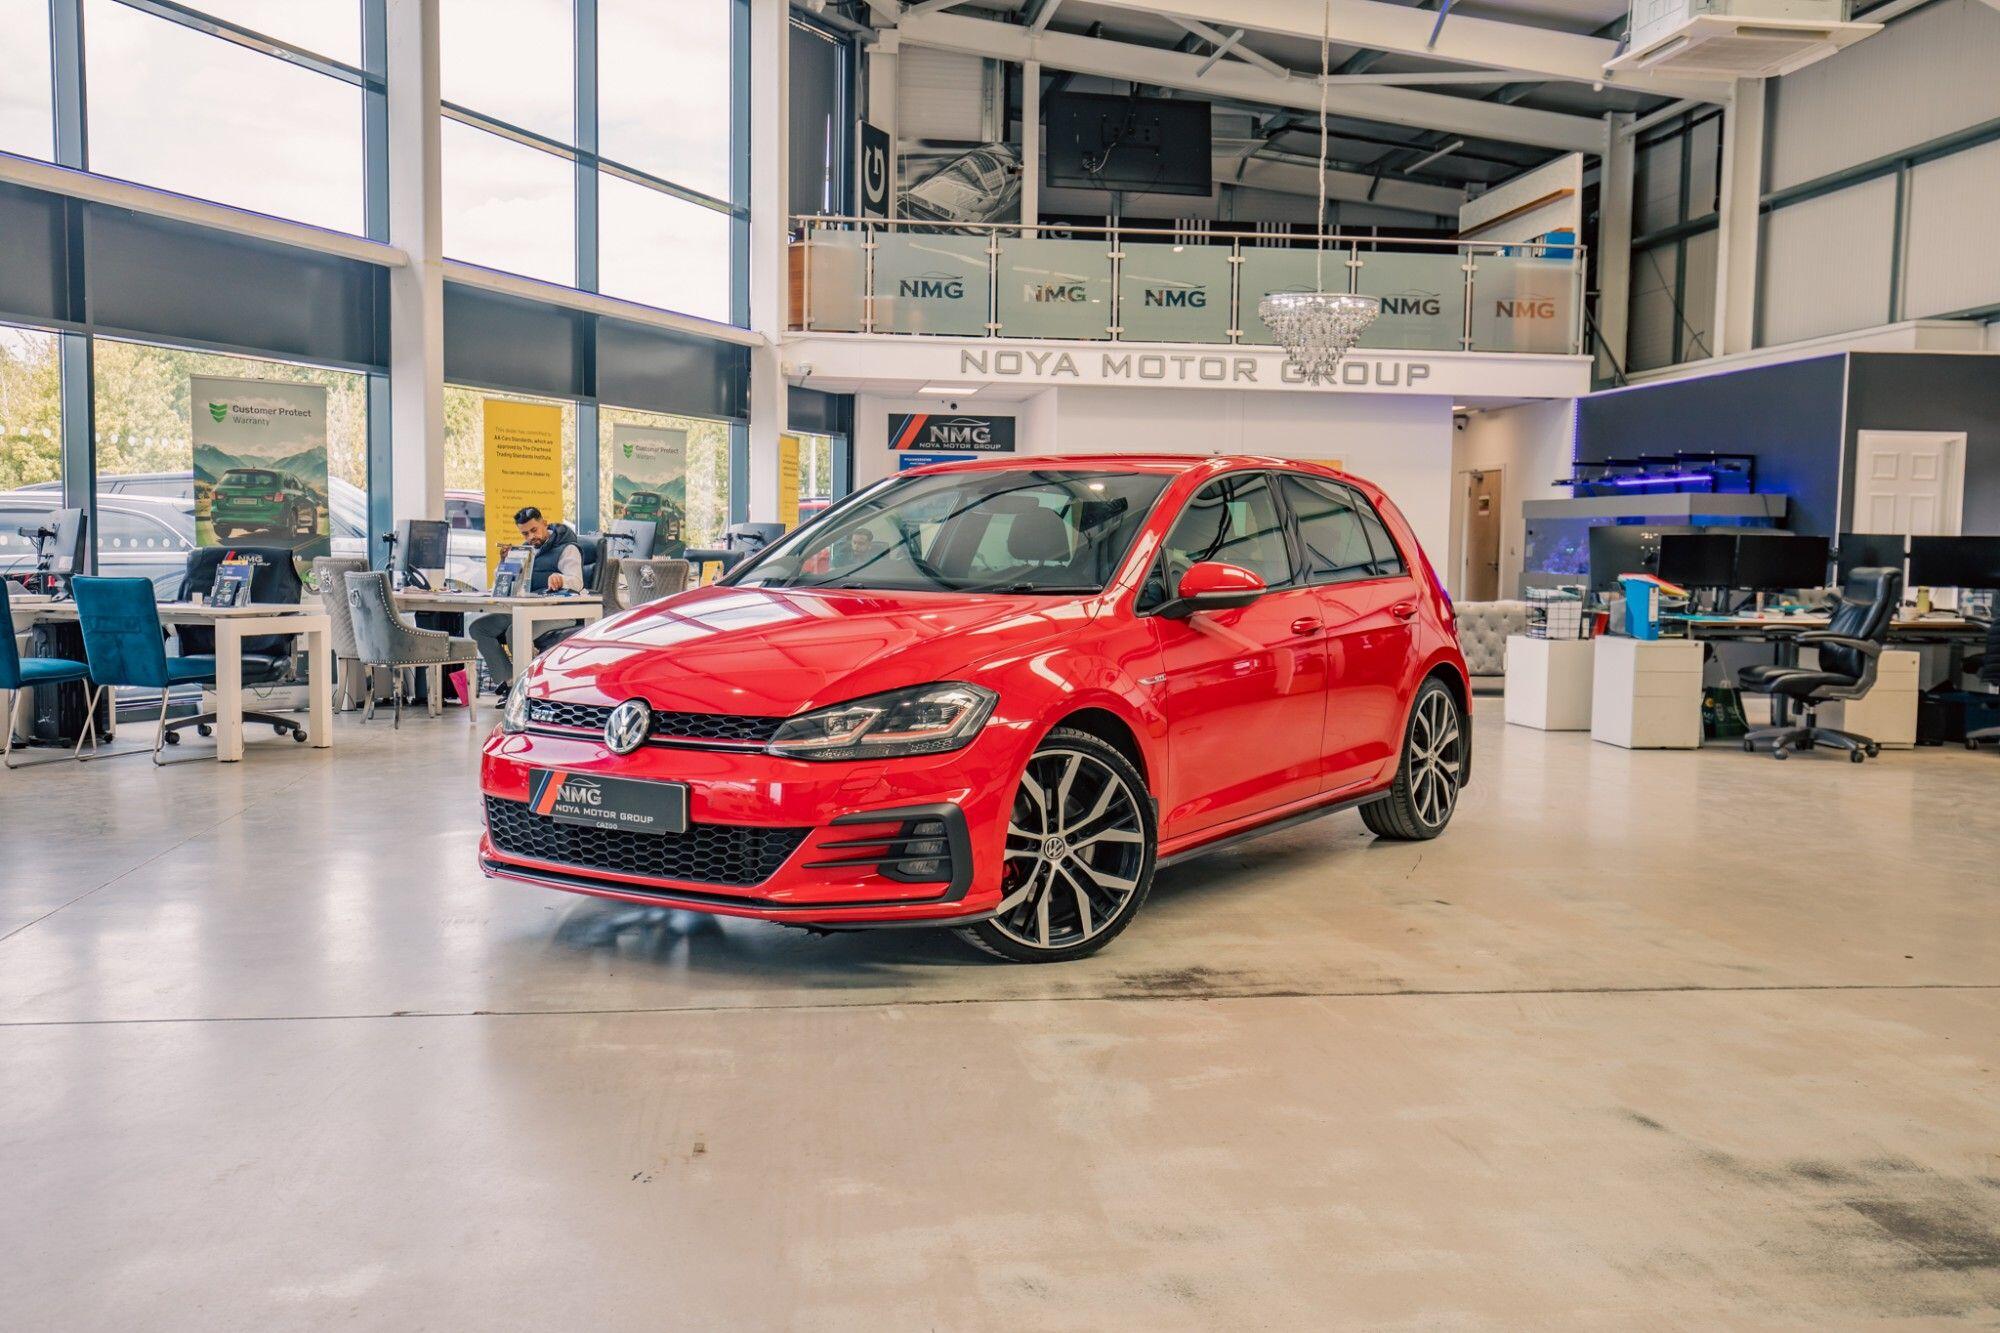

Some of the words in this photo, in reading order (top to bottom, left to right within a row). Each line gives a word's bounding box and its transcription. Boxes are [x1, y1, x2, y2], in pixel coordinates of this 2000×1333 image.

[900, 280, 964, 299] NMG
[1023, 284, 1086, 302] NMG
[1145, 290, 1206, 308] NMG
[1381, 298, 1440, 315] NMG
[1496, 300, 1555, 318] NMG
[960, 350, 1080, 376] NOYA
[1102, 353, 1258, 382] MOTOR
[232, 404, 276, 414] Customer
[278, 408, 312, 418] Protect
[233, 416, 270, 426] Warranty
[929, 426, 991, 444] NMG
[556, 785, 602, 806] NMG
[556, 804, 580, 814] NOYA
[584, 807, 616, 820] MOTOR
[620, 812, 654, 824] GROUP
